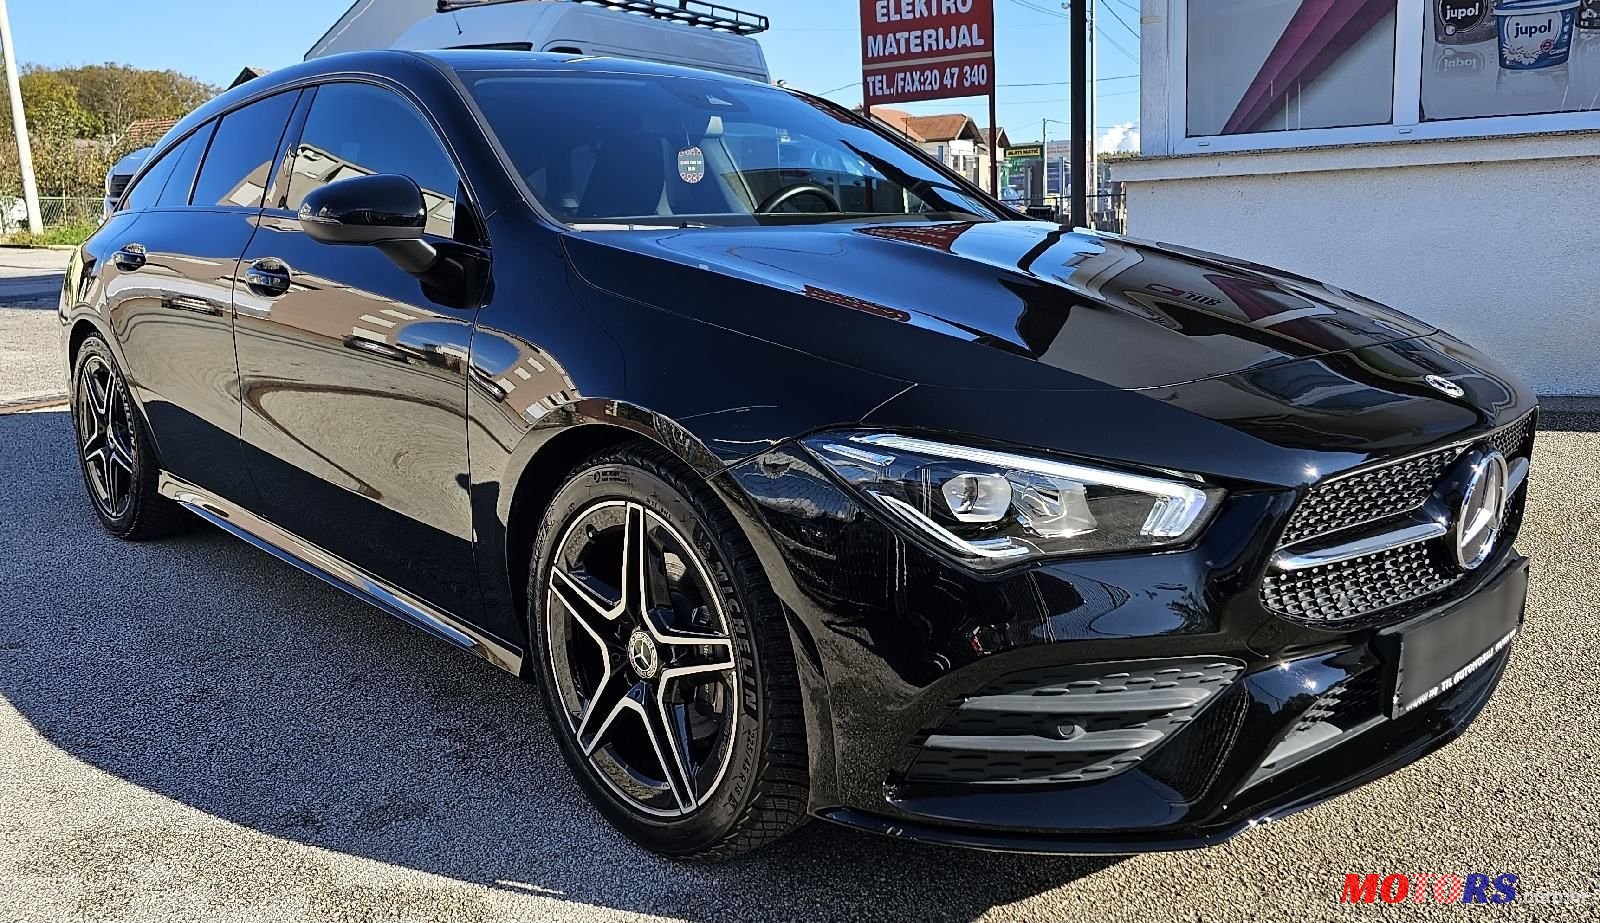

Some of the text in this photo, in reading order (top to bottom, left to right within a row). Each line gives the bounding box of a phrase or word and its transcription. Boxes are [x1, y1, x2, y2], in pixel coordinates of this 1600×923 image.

[1446, 3, 1479, 19] jupol
[867, 23, 985, 58] MATERIJAL
[1514, 19, 1552, 38] jupol
[943, 67, 960, 89] 47
[963, 64, 987, 87] 340
[714, 560, 758, 711] MICHELIN
